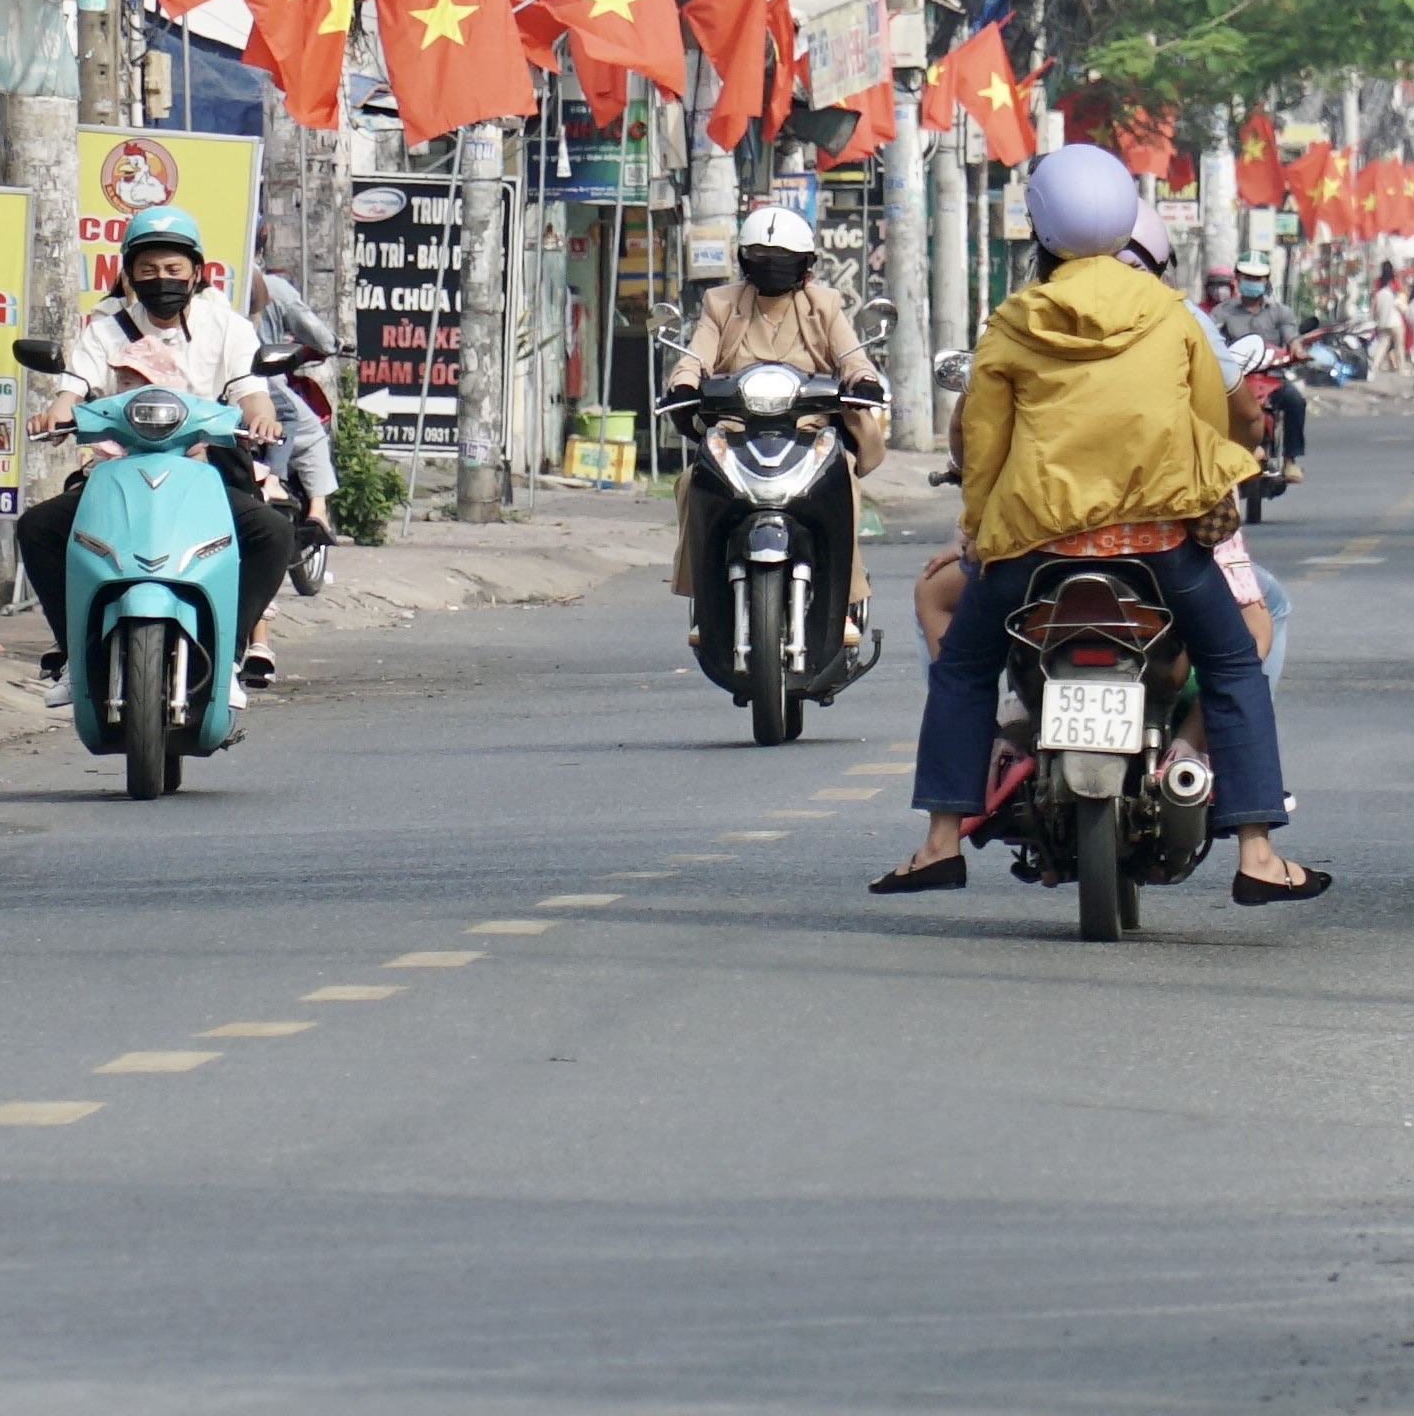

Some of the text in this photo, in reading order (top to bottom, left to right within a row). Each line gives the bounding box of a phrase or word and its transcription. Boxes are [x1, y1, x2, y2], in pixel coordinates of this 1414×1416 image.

[355, 233, 377, 268] ẢO
[380, 236, 405, 269] TRÌ
[356, 278, 387, 311] ỬA
[382, 318, 461, 349] RỬA XE
[357, 355, 413, 384] HĂM
[1058, 685, 1128, 715] 59-C3
[1050, 717, 1134, 748] 265.47
